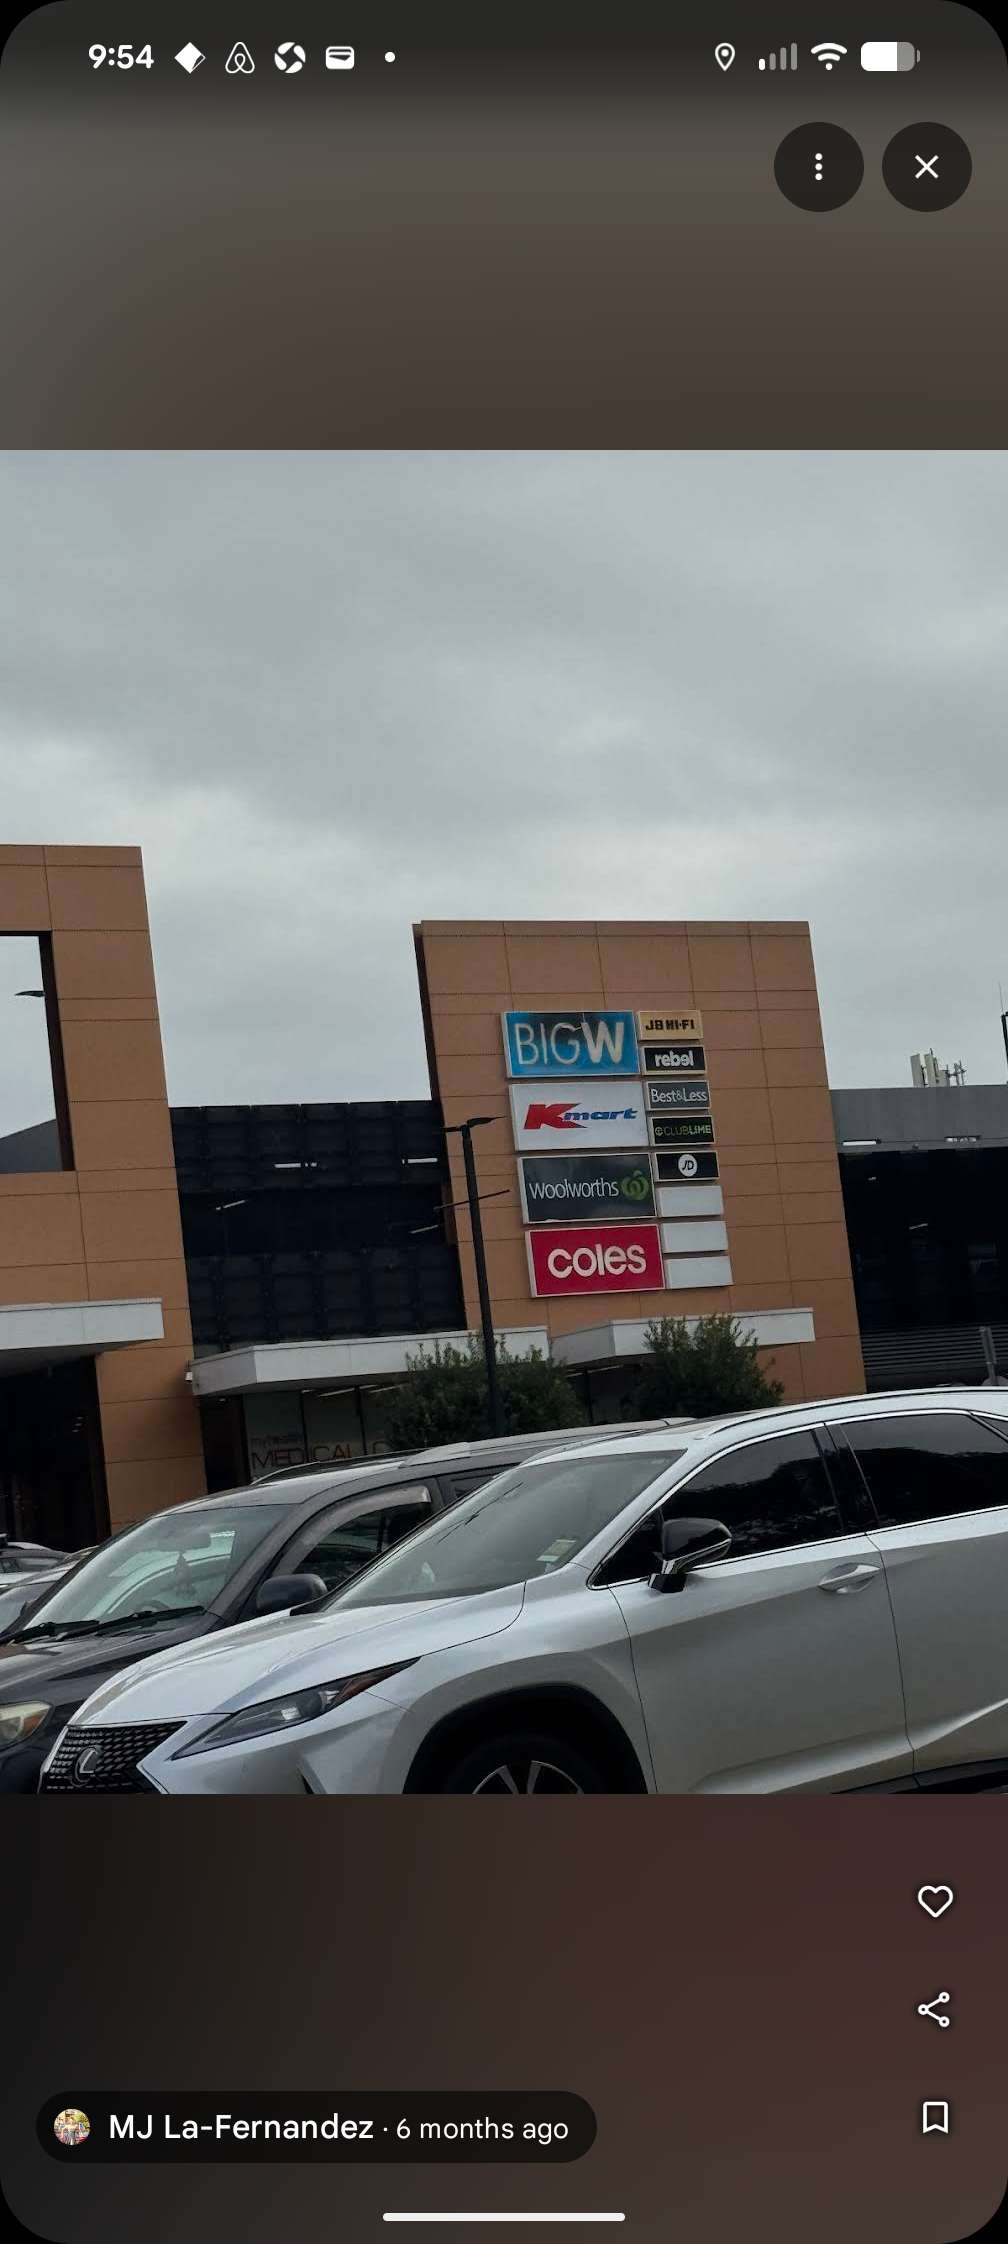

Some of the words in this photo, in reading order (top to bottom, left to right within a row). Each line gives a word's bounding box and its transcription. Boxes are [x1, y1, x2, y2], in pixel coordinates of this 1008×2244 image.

[645, 1019, 664, 1031] JB
[654, 1049, 694, 1067] rebel
[524, 1103, 638, 1130] Kmart
[681, 1160, 695, 1171] JD
[547, 1243, 647, 1279] coles
